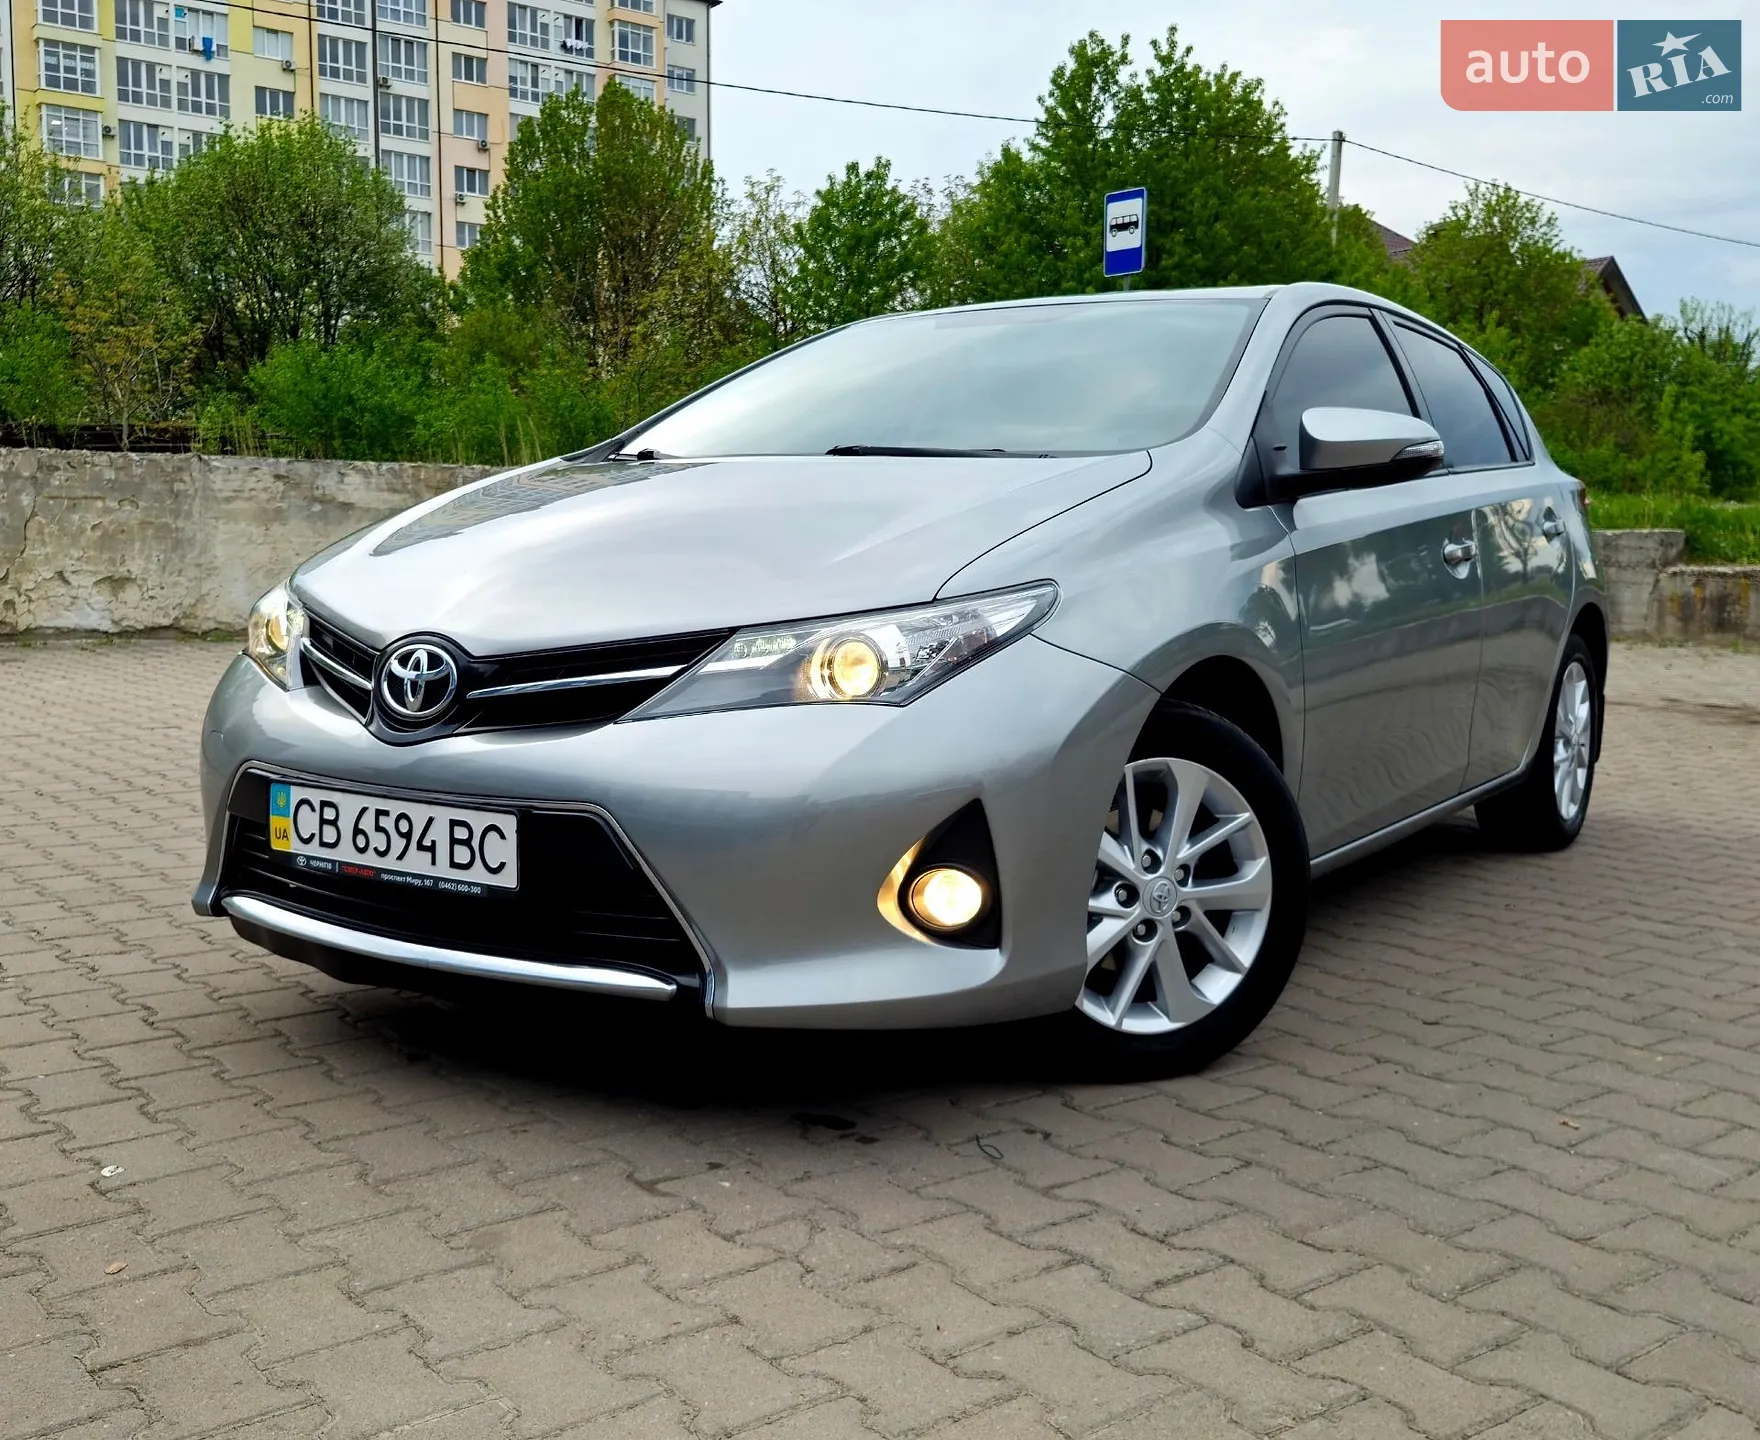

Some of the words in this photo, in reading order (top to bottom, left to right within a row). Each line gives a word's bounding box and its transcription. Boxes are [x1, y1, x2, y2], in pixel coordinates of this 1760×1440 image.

[274, 826, 289, 842] UA
[292, 797, 342, 849] CB
[351, 806, 437, 866] 6594
[448, 818, 507, 875] BC
